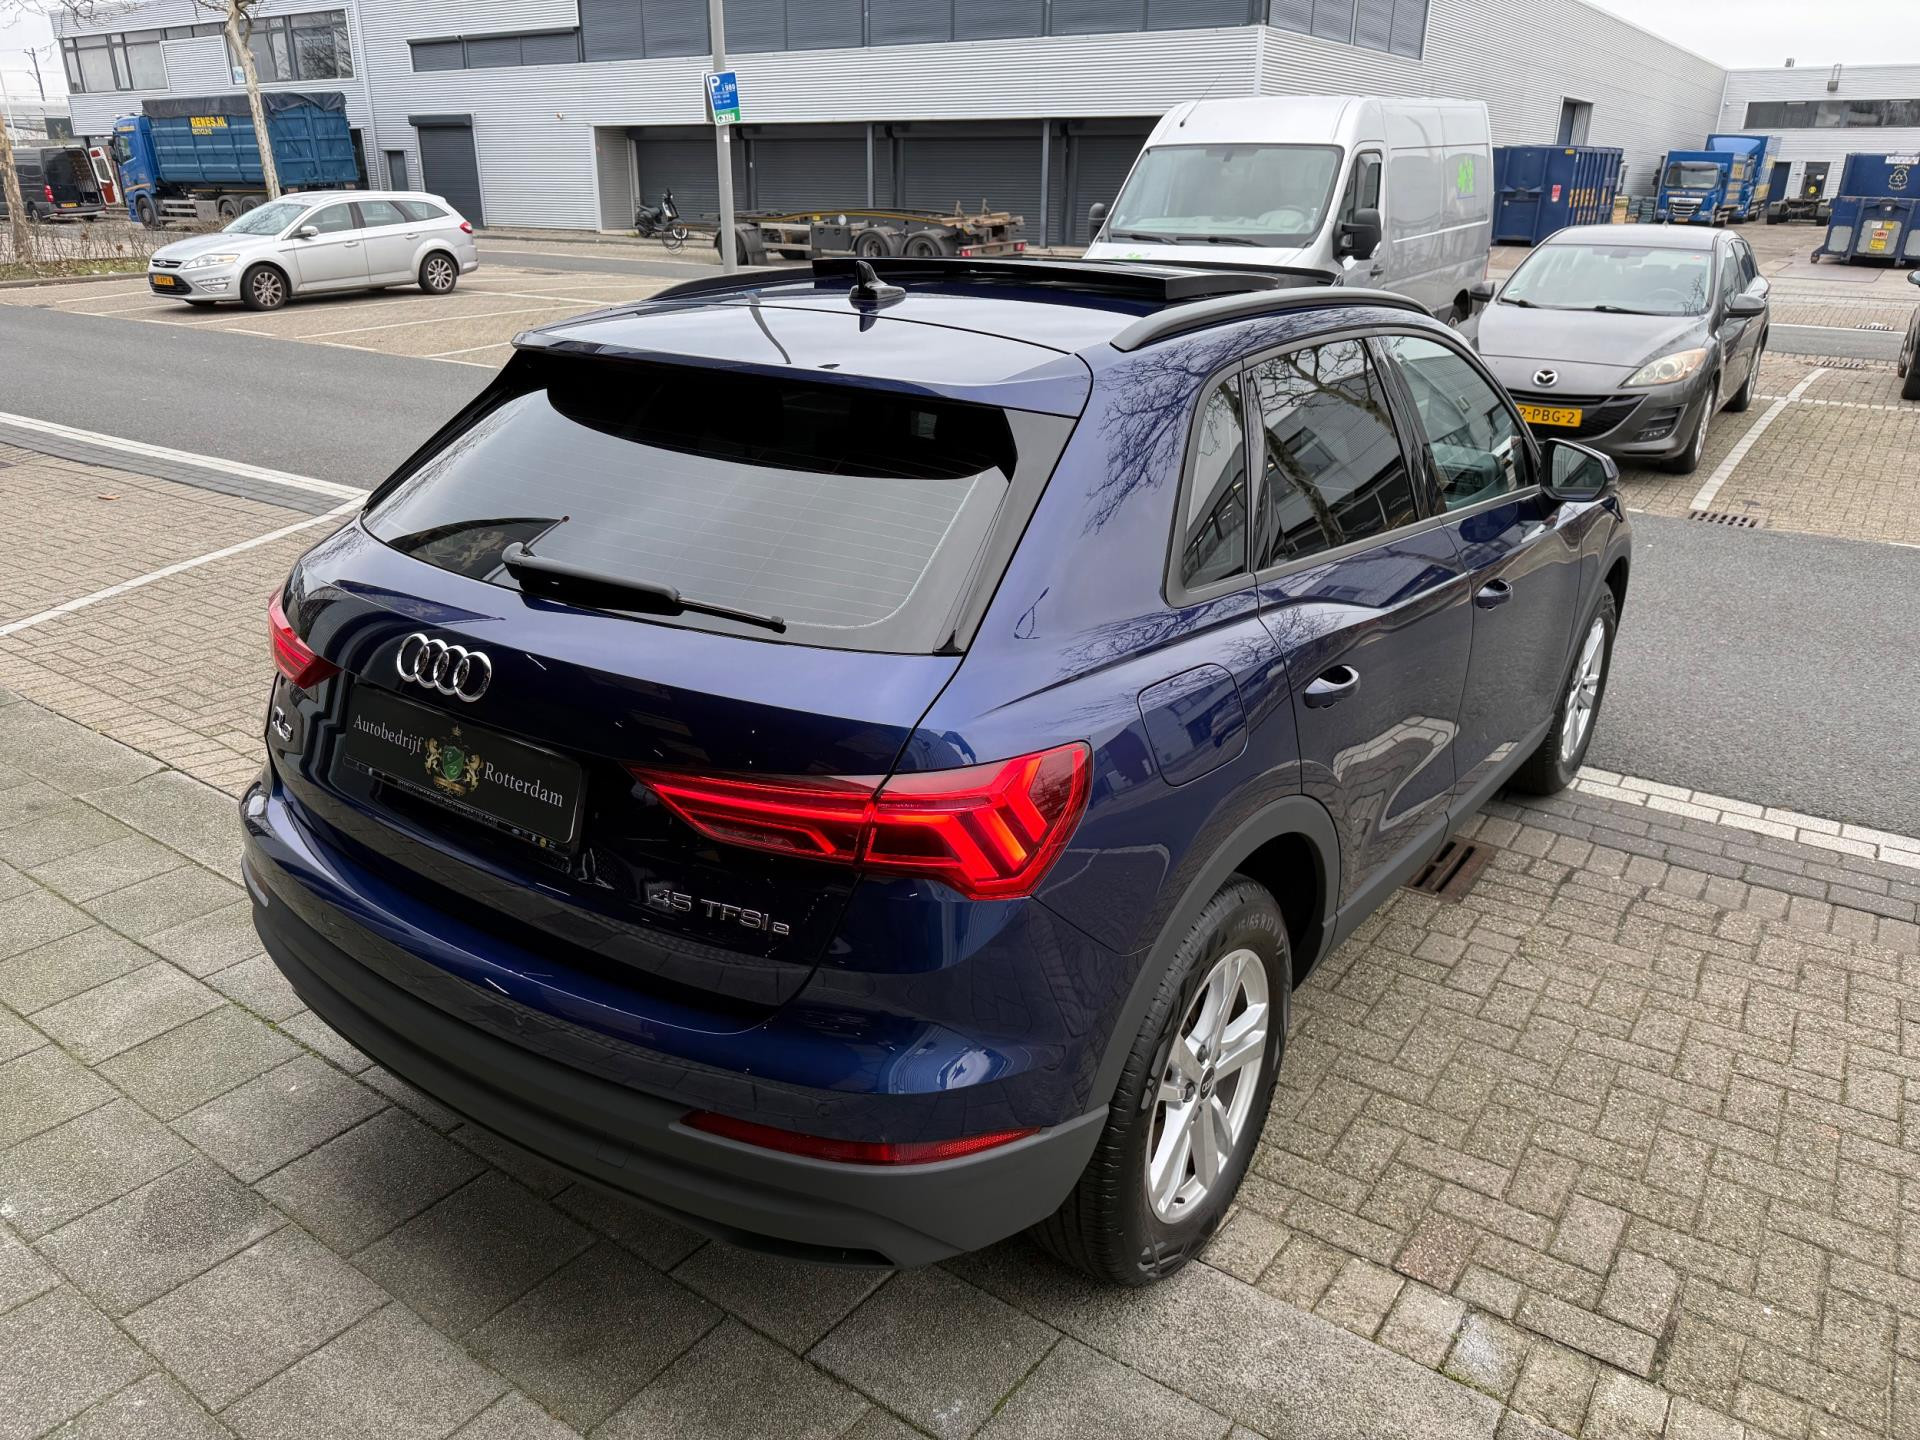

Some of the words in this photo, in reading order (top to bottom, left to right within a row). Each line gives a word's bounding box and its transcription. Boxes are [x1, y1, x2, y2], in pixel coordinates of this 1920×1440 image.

[709, 76, 720, 92] P
[353, 714, 424, 756] Autobedrijf
[484, 761, 564, 808] Rotterdam
[650, 889, 692, 912] 45
